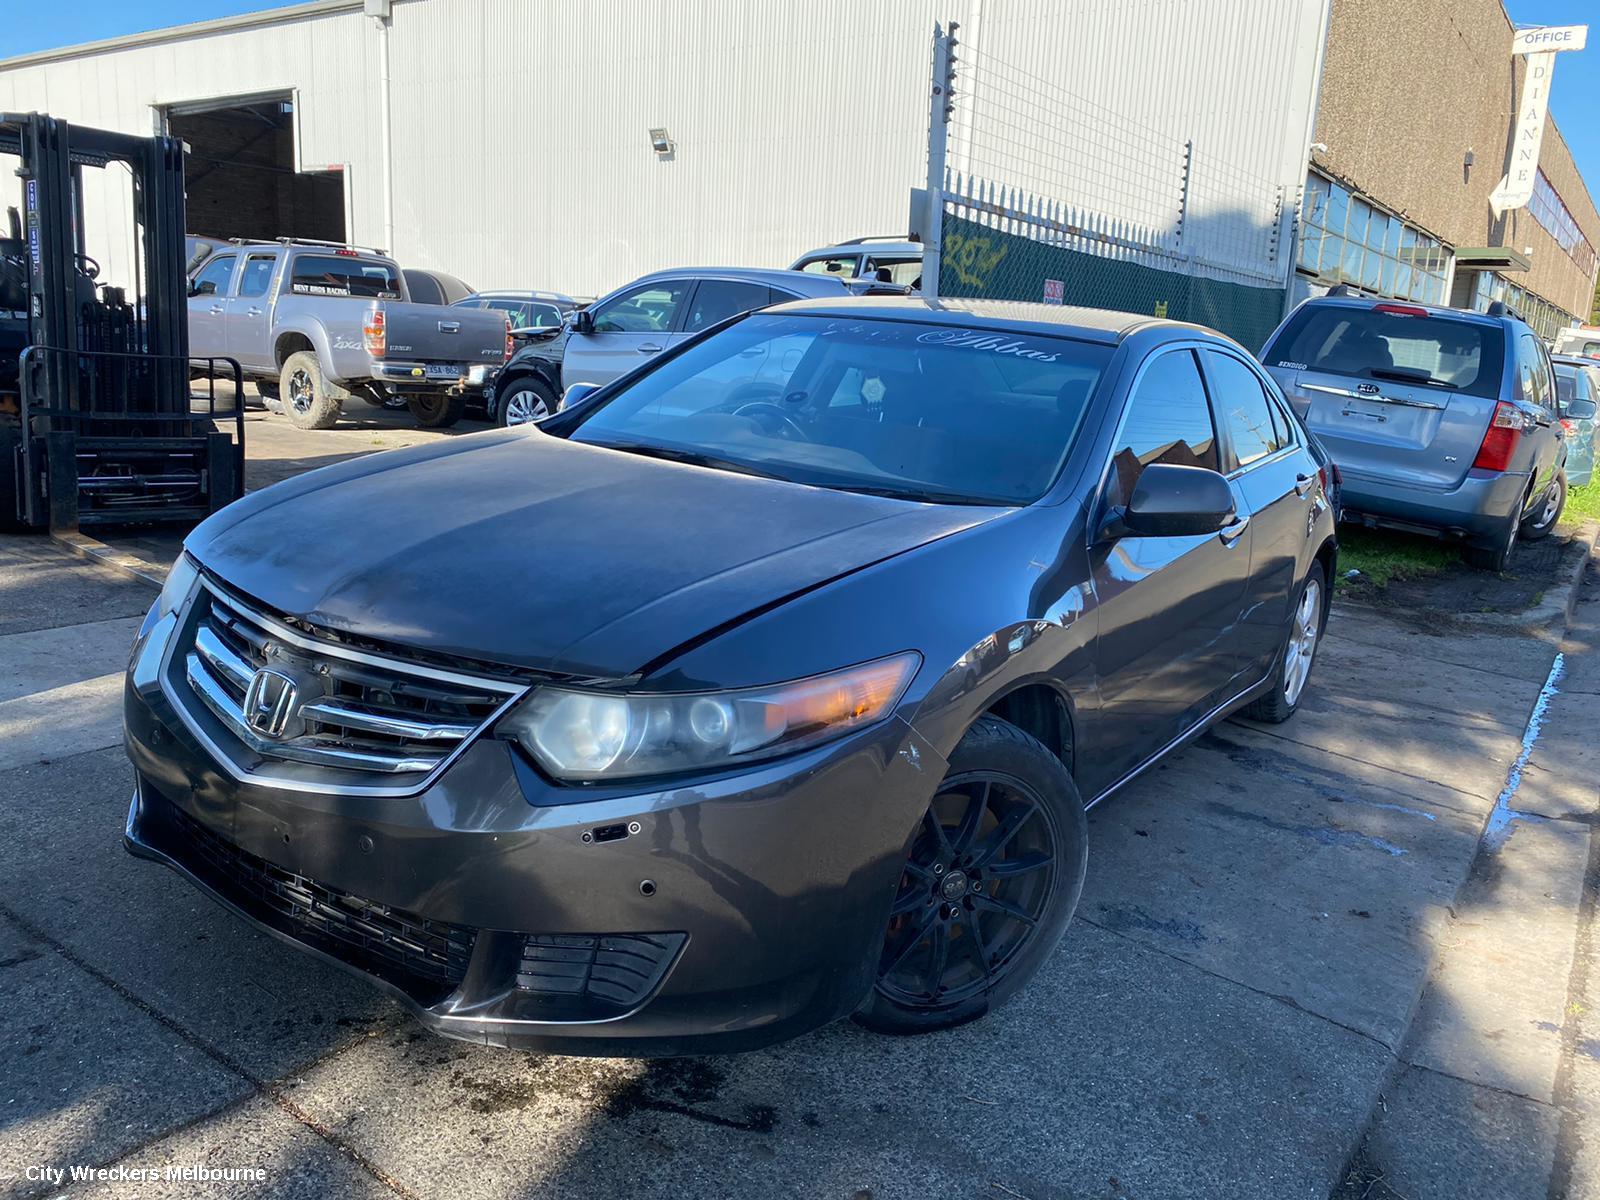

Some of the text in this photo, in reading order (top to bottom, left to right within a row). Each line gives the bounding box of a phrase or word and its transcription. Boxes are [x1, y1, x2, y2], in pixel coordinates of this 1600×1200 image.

[1524, 31, 1573, 44] OFFICE
[1518, 66, 1545, 181] DIANNE
[293, 283, 309, 292] BENT
[326, 287, 348, 296] RACING
[916, 330, 1062, 362] Abbas
[1278, 360, 1308, 370] BENDIGO
[1358, 384, 1377, 393] KIA
